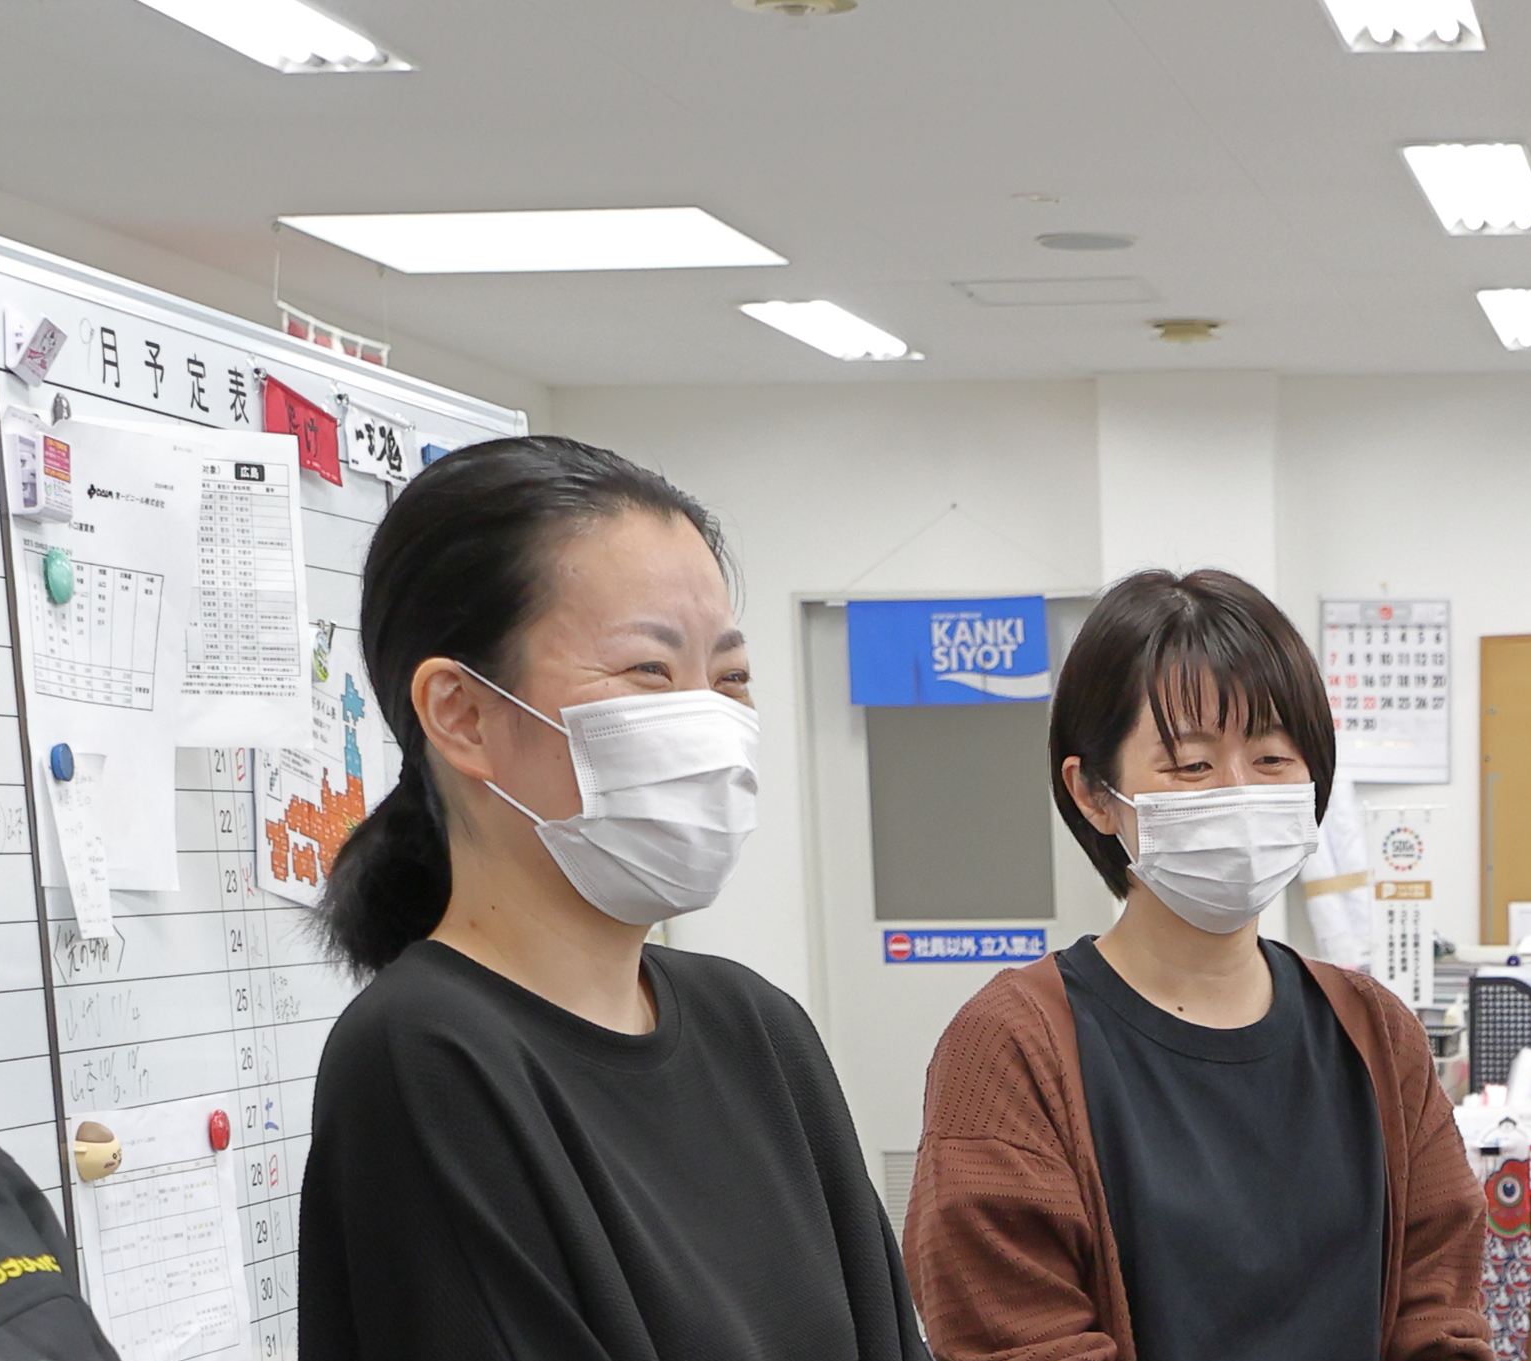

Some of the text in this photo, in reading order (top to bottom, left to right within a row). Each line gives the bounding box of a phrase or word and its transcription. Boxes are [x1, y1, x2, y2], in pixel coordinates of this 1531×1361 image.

[931, 617, 1025, 647] KANKI
[932, 643, 1018, 672] SIYOT
[215, 750, 227, 773] 21
[220, 809, 233, 833] 22
[225, 870, 238, 893] 23
[230, 929, 243, 953] 24
[914, 935, 1045, 958] 社員以外 立入禁止
[236, 989, 248, 1012] 25
[241, 1048, 253, 1070] 26
[246, 1105, 257, 1129] 27
[251, 1163, 263, 1187] 28
[256, 1220, 268, 1244] 29
[261, 1278, 273, 1301] 30
[265, 1334, 277, 1357] 31
